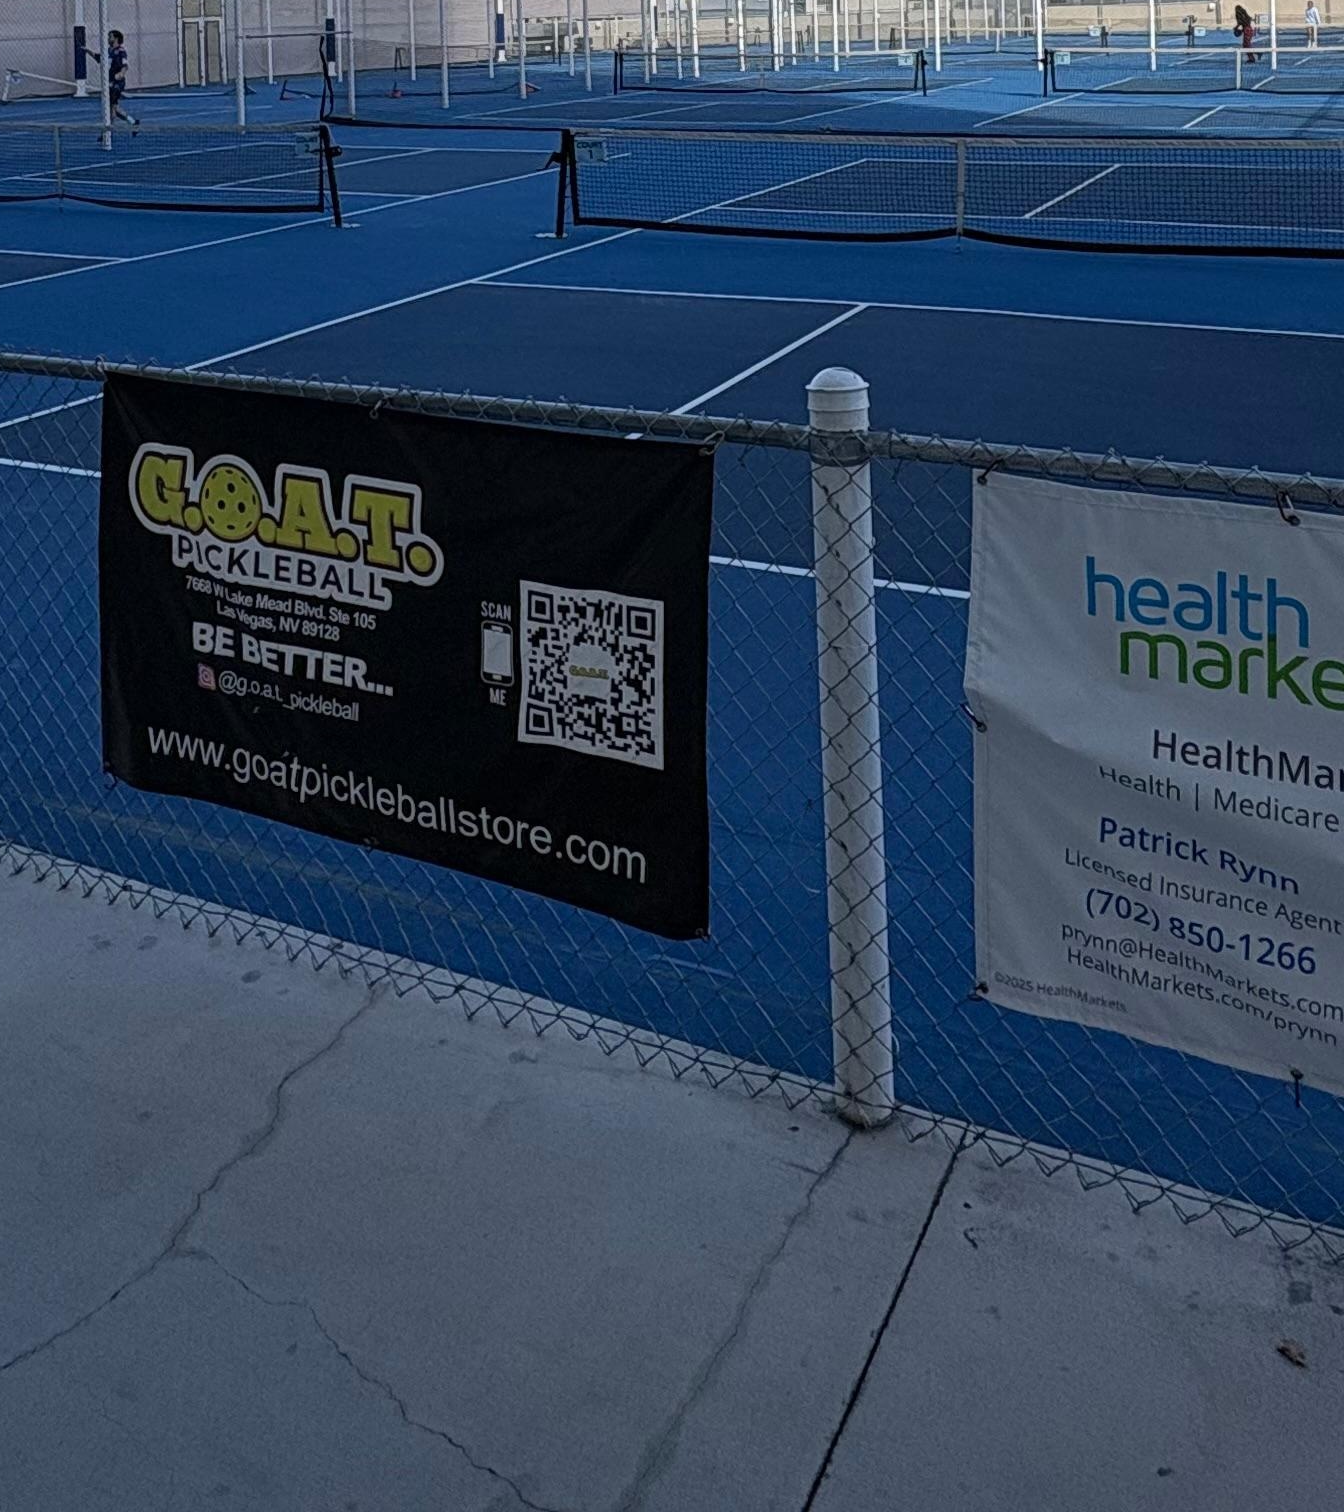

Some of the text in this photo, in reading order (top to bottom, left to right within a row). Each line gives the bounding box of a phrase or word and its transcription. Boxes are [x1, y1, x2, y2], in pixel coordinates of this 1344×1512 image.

[132, 445, 442, 582] G.O.A.T.
[177, 535, 386, 602] PICKLEBALL
[213, 581, 225, 598] W
[225, 588, 253, 607] Lake
[256, 595, 291, 614] Mead
[328, 607, 350, 625] Ste
[353, 612, 376, 630] 105
[1086, 555, 1310, 648] health
[217, 600, 340, 641] Las Vegas, NV 89128
[481, 601, 512, 620] SCAN
[192, 622, 394, 697] BE BETTER...
[490, 688, 507, 706] ME
[148, 725, 647, 883] www.goatpickleballstore.com
[1099, 765, 1182, 802] Health
[1213, 788, 1340, 832] Medicare
[1064, 848, 1343, 935] Licensed Insurance Agent
[1100, 816, 1300, 896] Patrick Rynn
[1086, 887, 1317, 976] (702) 850-1266
[1061, 921, 1344, 1023] prynn@HealthMarkets.com
[1067, 947, 1338, 1047] HealthMarkets.com/prynn
